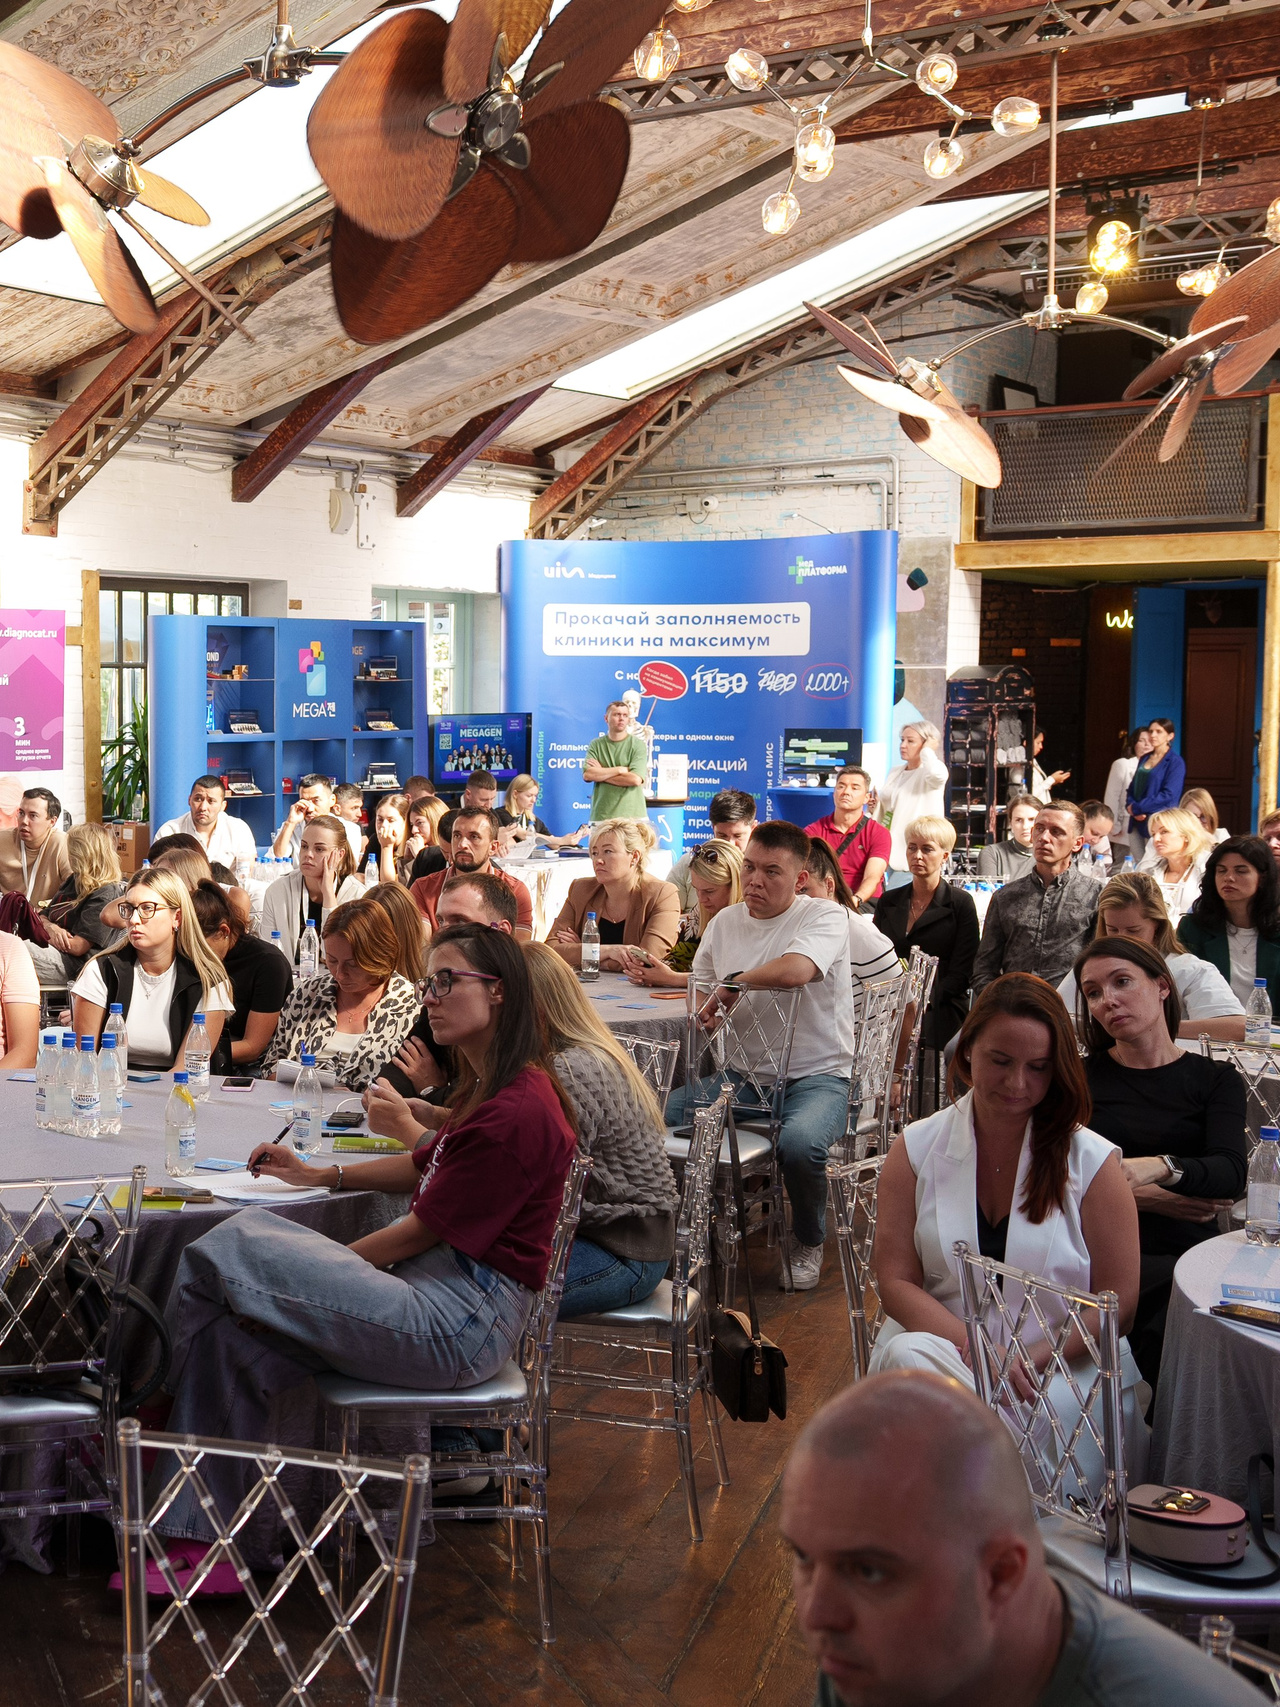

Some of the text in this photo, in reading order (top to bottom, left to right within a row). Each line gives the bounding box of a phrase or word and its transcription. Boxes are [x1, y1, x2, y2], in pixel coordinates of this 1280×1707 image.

[798, 565, 848, 576] ПЛАТФОРМА
[554, 612, 801, 628] Прокачай заполняемость
[554, 635, 770, 650] клиники на максимум
[14, 716, 26, 736] 3
[460, 728, 502, 737] MEGAGEN
[686, 734, 710, 742] одном
[549, 743, 589, 751] Лояльно
[536, 731, 545, 779] прибыли
[766, 742, 774, 768] МИС
[548, 758, 585, 769] СИСТ
